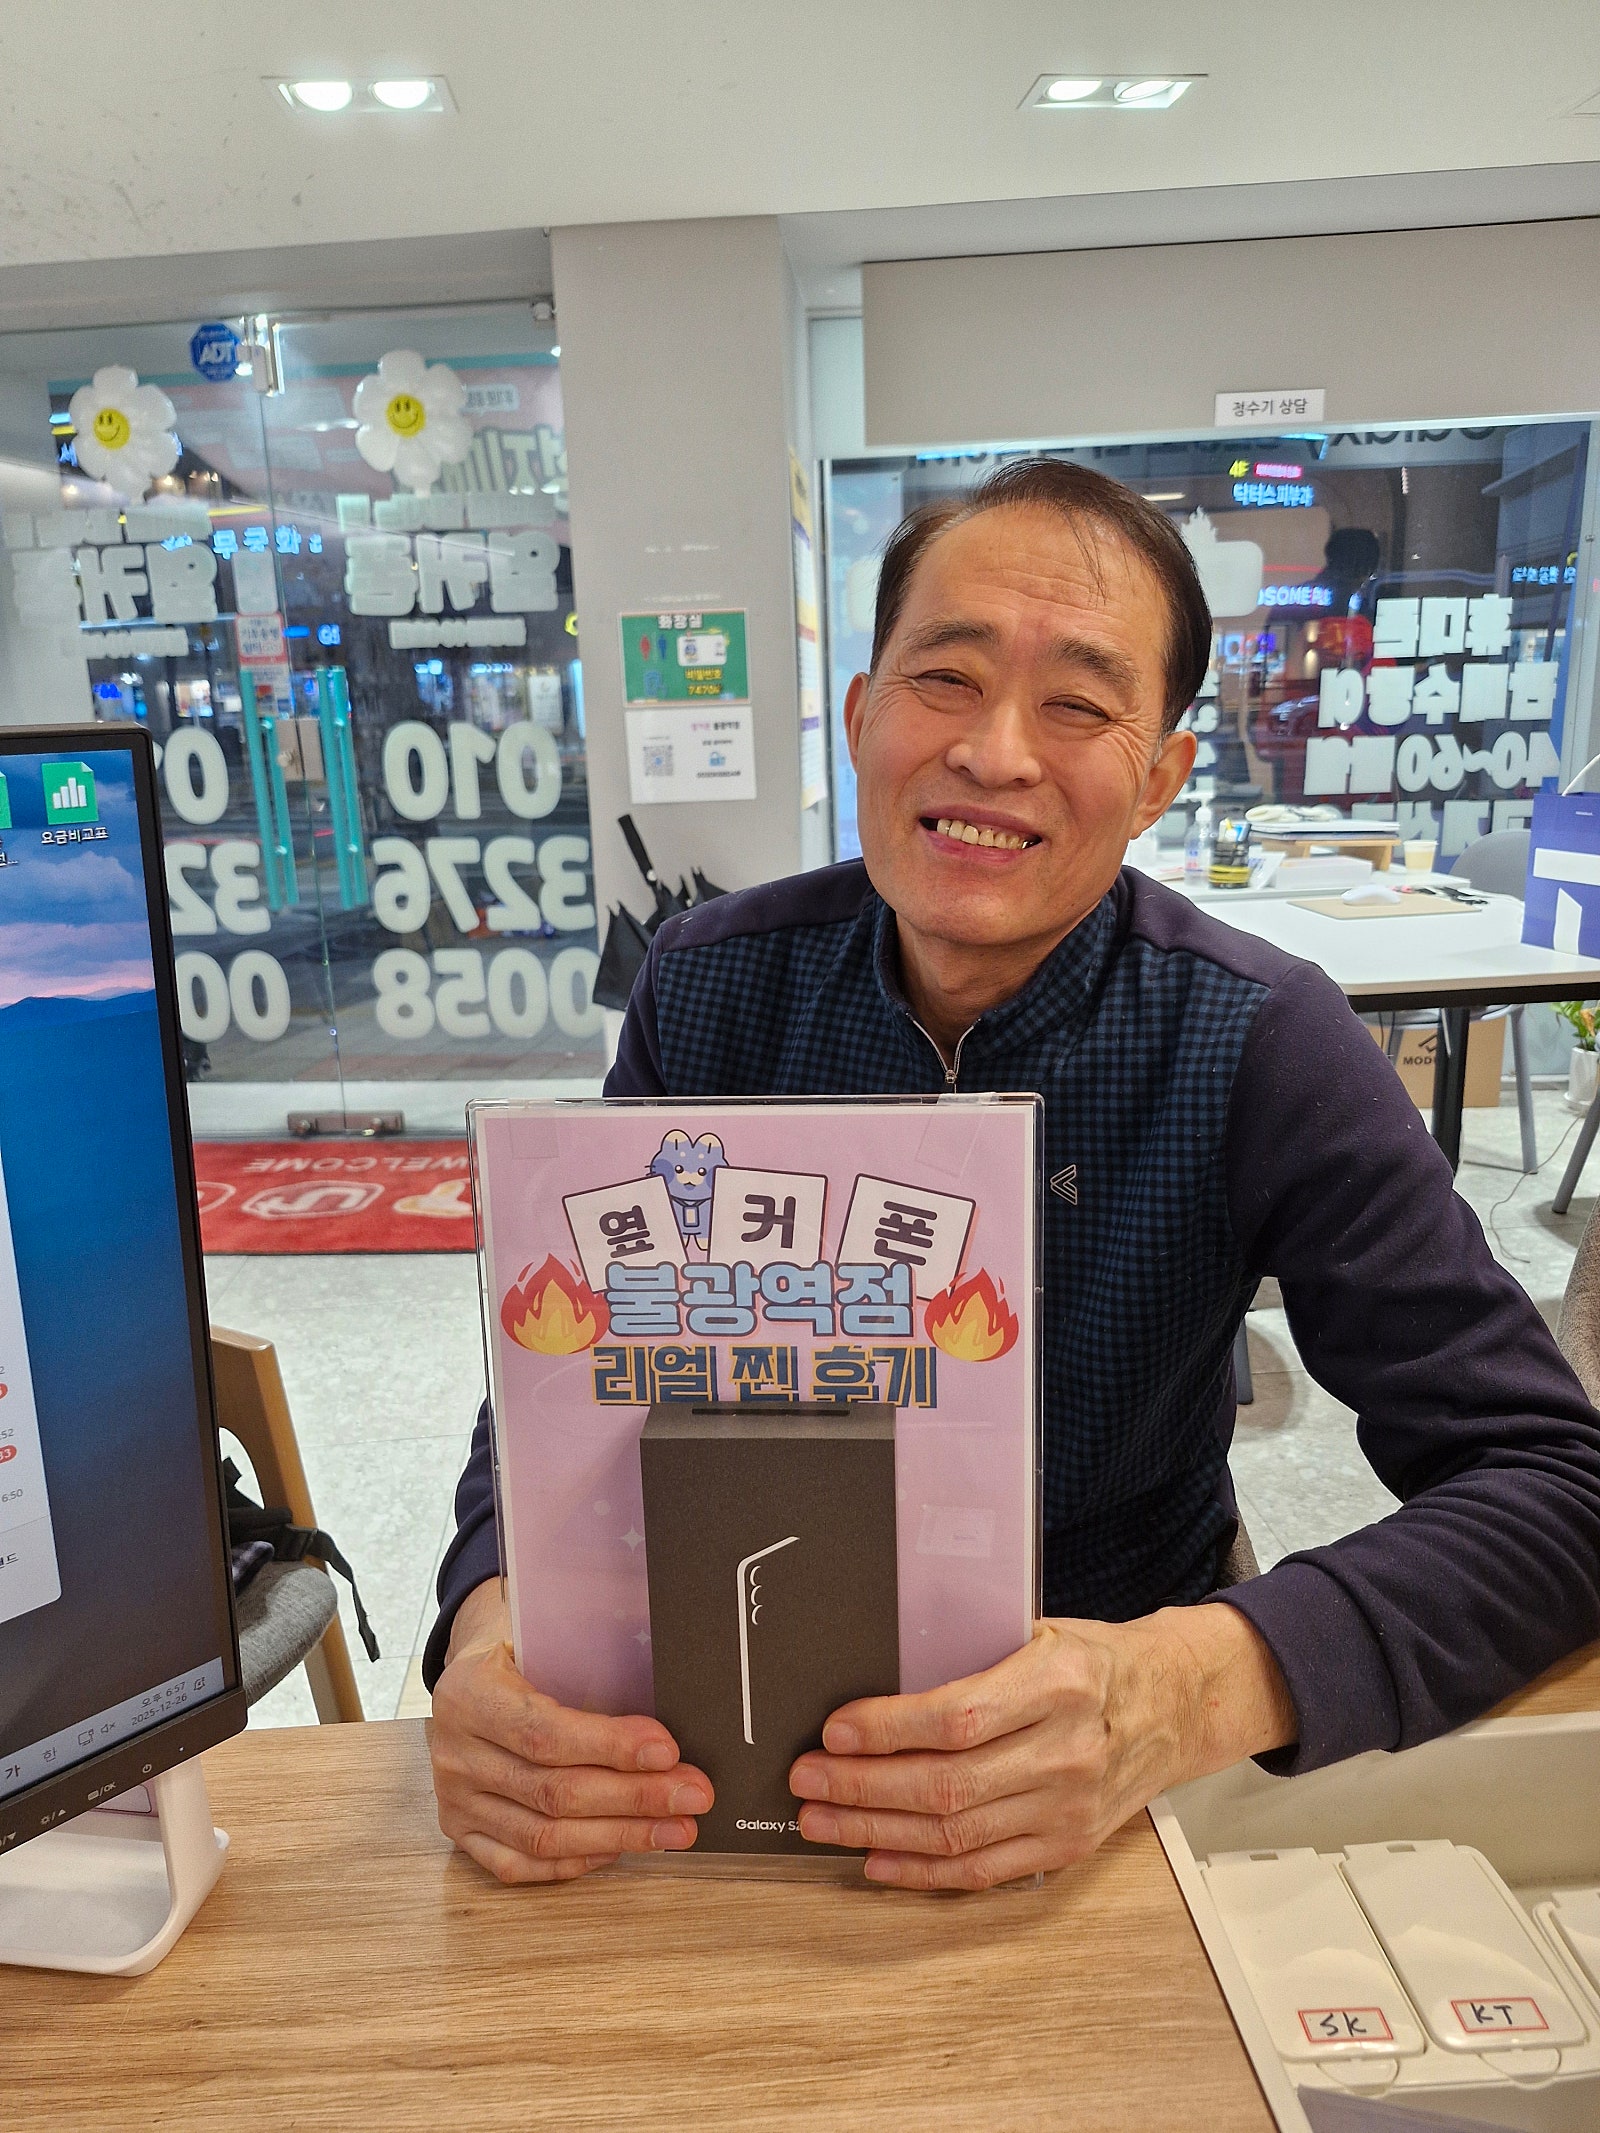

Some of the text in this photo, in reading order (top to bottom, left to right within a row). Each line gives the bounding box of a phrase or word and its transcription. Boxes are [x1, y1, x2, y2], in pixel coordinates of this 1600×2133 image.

[1232, 398, 1309, 417] 정수기 상담
[41, 826, 109, 845] 요금비교표
[241, 1156, 468, 1173] WELCOME
[599, 1193, 938, 1266] 옆 커 폰
[604, 1260, 916, 1338] 불광역점
[591, 1344, 937, 1408] 리얼 찐 후기
[1, 1488, 24, 1503] 6:50
[141, 1681, 186, 1709] 오후 6:57
[131, 1693, 188, 1726] 2025-12-26
[43, 1747, 58, 1763] 한
[5, 1764, 21, 1780] 가
[736, 1819, 801, 1833] Galaxy S2
[1470, 2002, 1513, 2026] KT
[1319, 2012, 1367, 2038] SK
